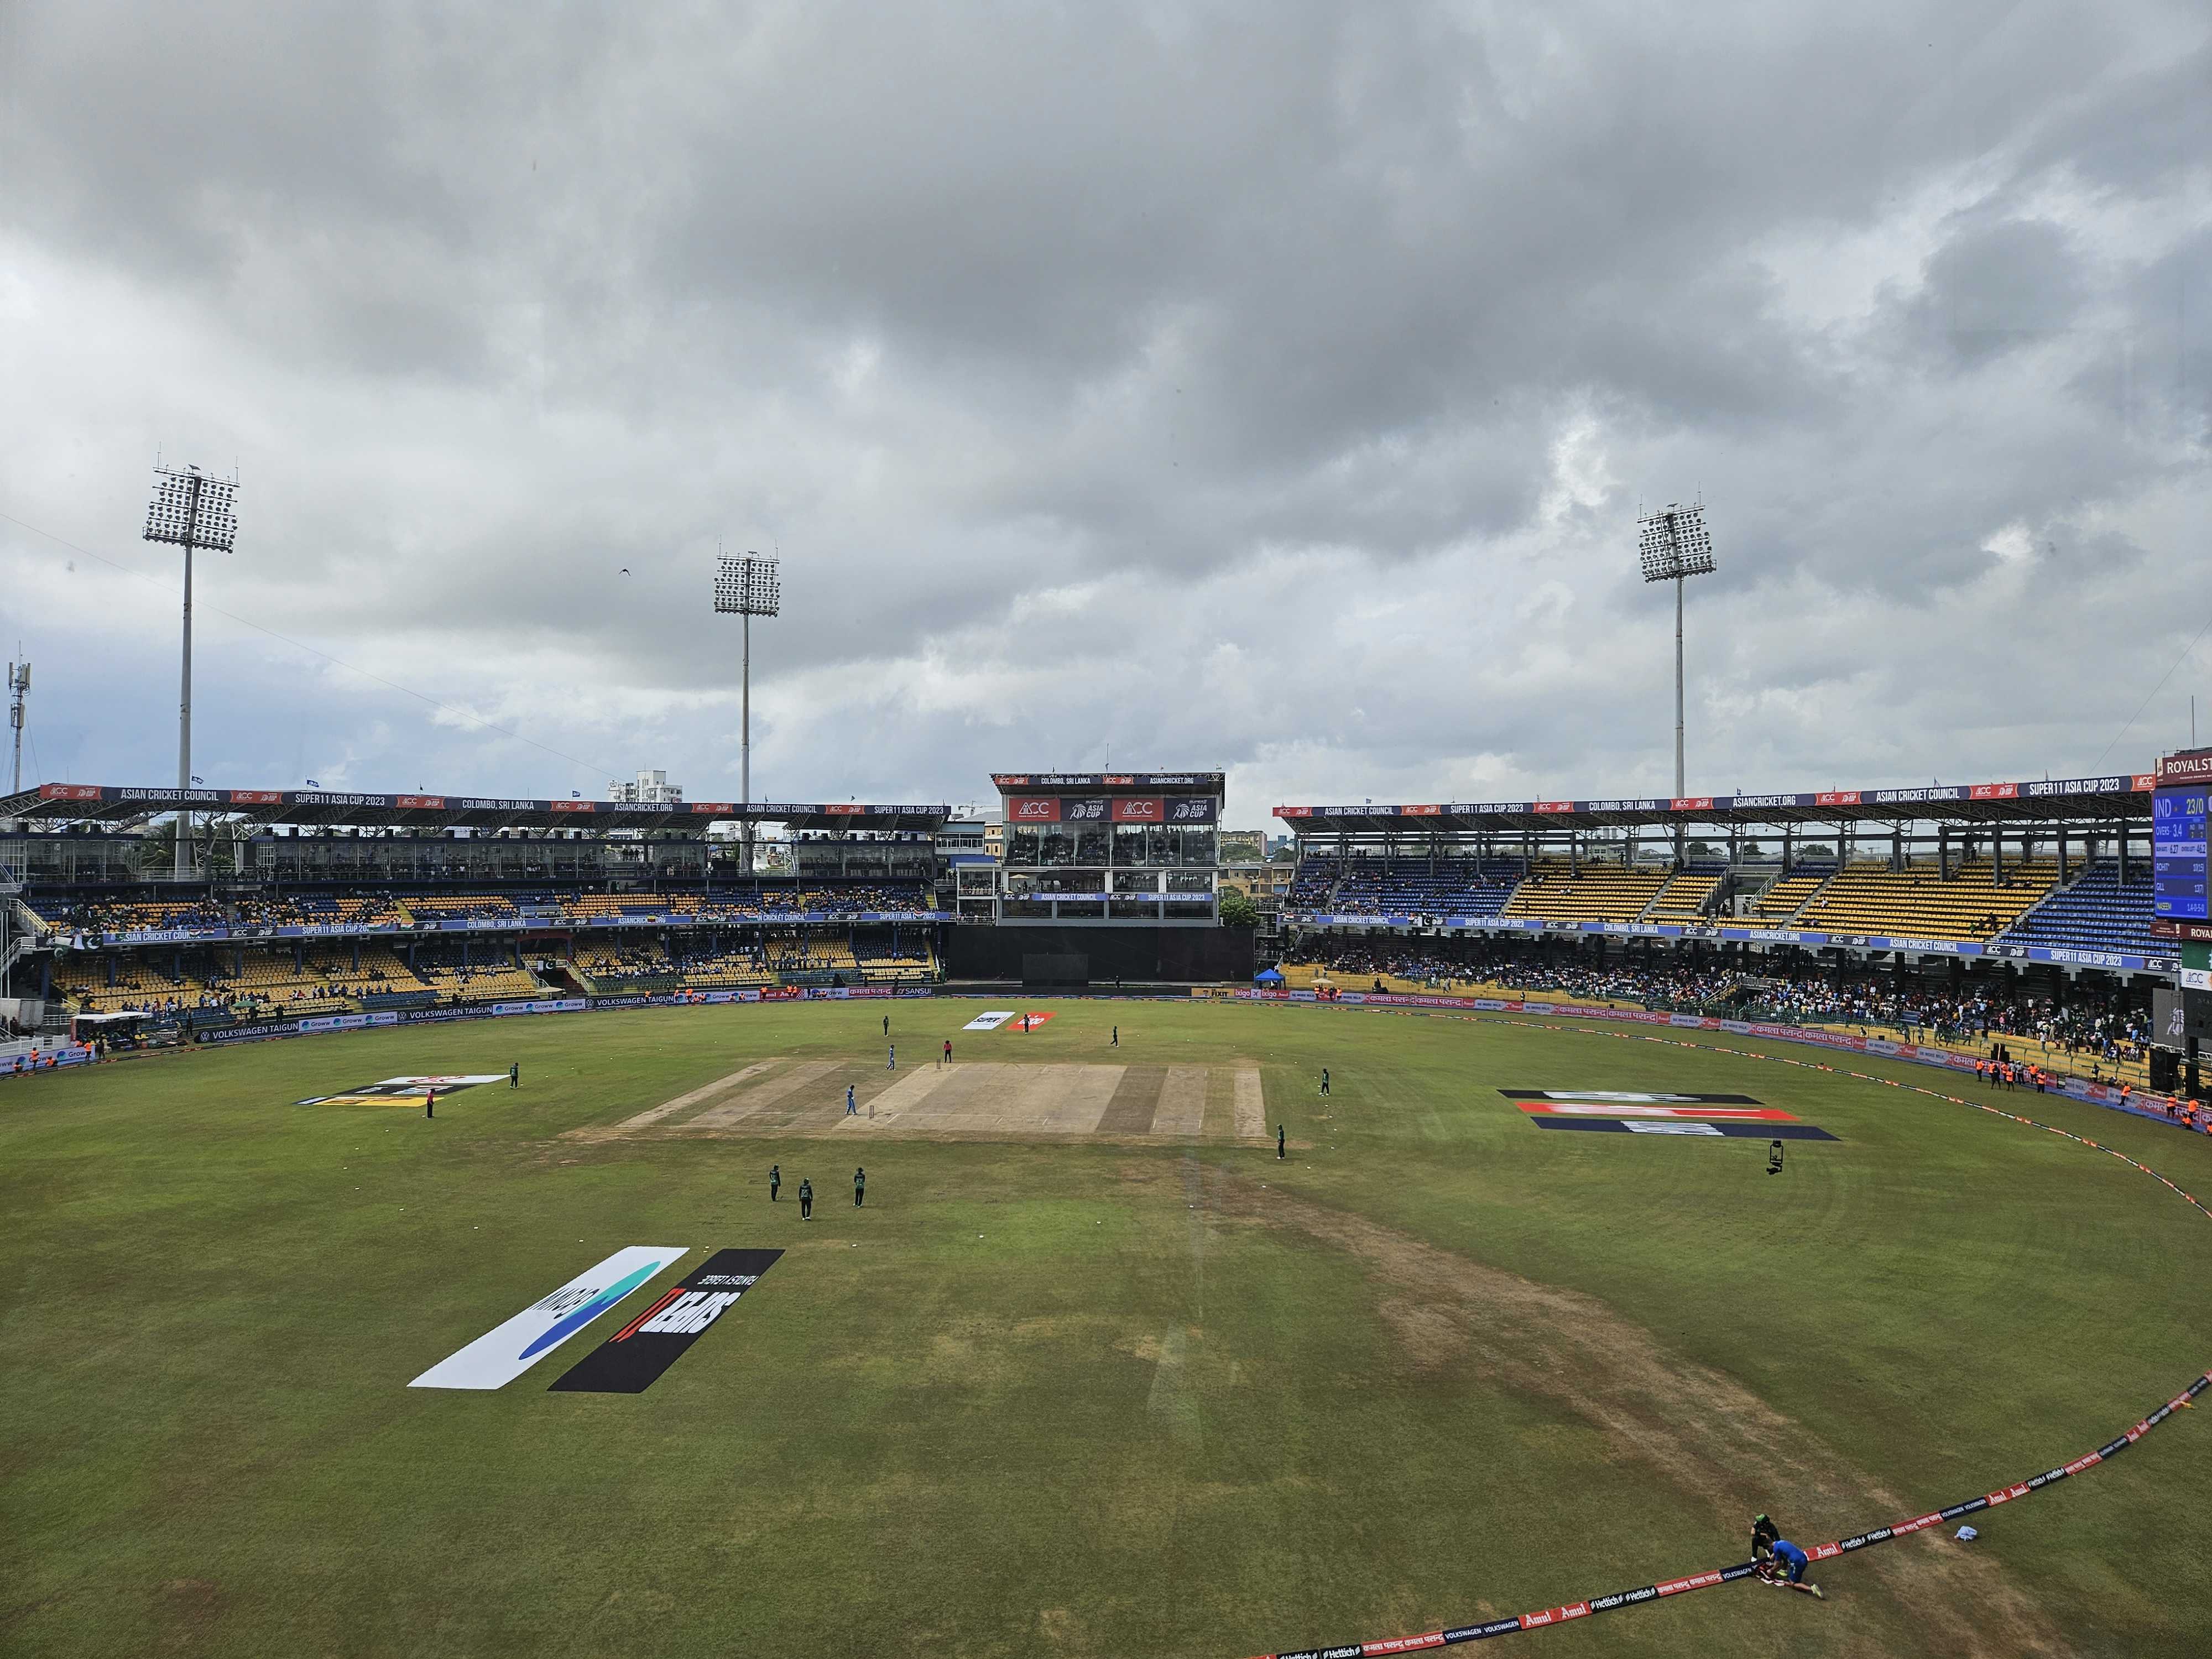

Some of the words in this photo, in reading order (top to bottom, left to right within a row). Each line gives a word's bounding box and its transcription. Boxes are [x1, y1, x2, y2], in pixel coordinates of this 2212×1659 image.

[2167, 759, 2200, 774] ROYAL
[2030, 782, 2063, 795] SUPER11
[2064, 781, 2082, 793] ASIA
[2084, 780, 2098, 792] CUP
[2100, 778, 2119, 791] 2023
[121, 789, 146, 799] ASIAN
[148, 790, 182, 800] CRICKET
[185, 790, 218, 801] COUNCIL
[295, 794, 328, 804] SUPER11
[331, 795, 348, 805] ASIA
[349, 796, 364, 805] CUP
[366, 796, 384, 806] 2023
[1733, 795, 1796, 807] ASIANCRICKET.ORG
[1876, 791, 1897, 802] ASIAN
[1898, 789, 1927, 801] CRICKET
[1929, 788, 1959, 800] COUNCIL
[463, 800, 497, 810] COLOMBO,
[499, 801, 510, 809] SRI
[512, 801, 534, 810] LANKA
[614, 803, 672, 811] ASIANCRICKET.ORG
[1019, 802, 1048, 815] ACC
[1123, 802, 1152, 814] ACC
[1451, 805, 1478, 813] SUPER11
[1479, 805, 1493, 813] ASIA
[1507, 804, 1524, 812] 2023
[1589, 802, 1621, 811] COLOMBO,
[1623, 801, 1633, 810] SRI
[1635, 801, 1655, 810] LANKA
[2156, 799, 2171, 818] IND
[2187, 798, 2203, 815] 23/0
[2173, 823, 2182, 837] 3.4
[302, 926, 328, 934] SUPER11
[330, 925, 344, 933] ASIA
[1604, 924, 1630, 933] COLOMBO,
[1641, 925, 1658, 934] LANKA
[1750, 931, 1799, 941] ASIANCRICKET.ORG
[1890, 939, 1907, 949] ASIAN
[1908, 940, 1933, 951] CRICKET
[1934, 941, 1958, 952] COUNCIL
[2051, 950, 2077, 962] SUPER11
[2078, 952, 2091, 963] ASIA
[2093, 953, 2105, 965] CUP
[2106, 956, 2121, 966] 2023
[597, 997, 646, 1006] VOLKSWAGEN
[410, 1009, 462, 1019] VOLKSWAGEN
[1583, 1008, 1606, 1016] पसन्द
[1633, 1013, 1656, 1021] पसन्द
[213, 1026, 267, 1039] VOLKSWAGEN
[270, 1023, 298, 1031] TAIGUN
[1757, 1026, 1778, 1035] कमला
[1780, 1028, 1803, 1038] पसन्द
[1805, 1032, 1827, 1041] कमला
[1829, 1035, 1852, 1045] पसन्द
[1845, 1537, 1863, 1548] Hettich
[1816, 1541, 1838, 1557] Amul
[1723, 1567, 1752, 1579] VOLKSWAGEN
[1630, 1589, 1652, 1601] Hettich
[1595, 1596, 1619, 1609] Hettich
[1561, 1604, 1587, 1619] Amul
[1526, 1611, 1552, 1627] Amul
[1484, 1620, 1519, 1633] VOLKSWAGEN
[1445, 1627, 1481, 1640] VOLKSWAGEN
[1329, 1648, 1355, 1658] Hettich
